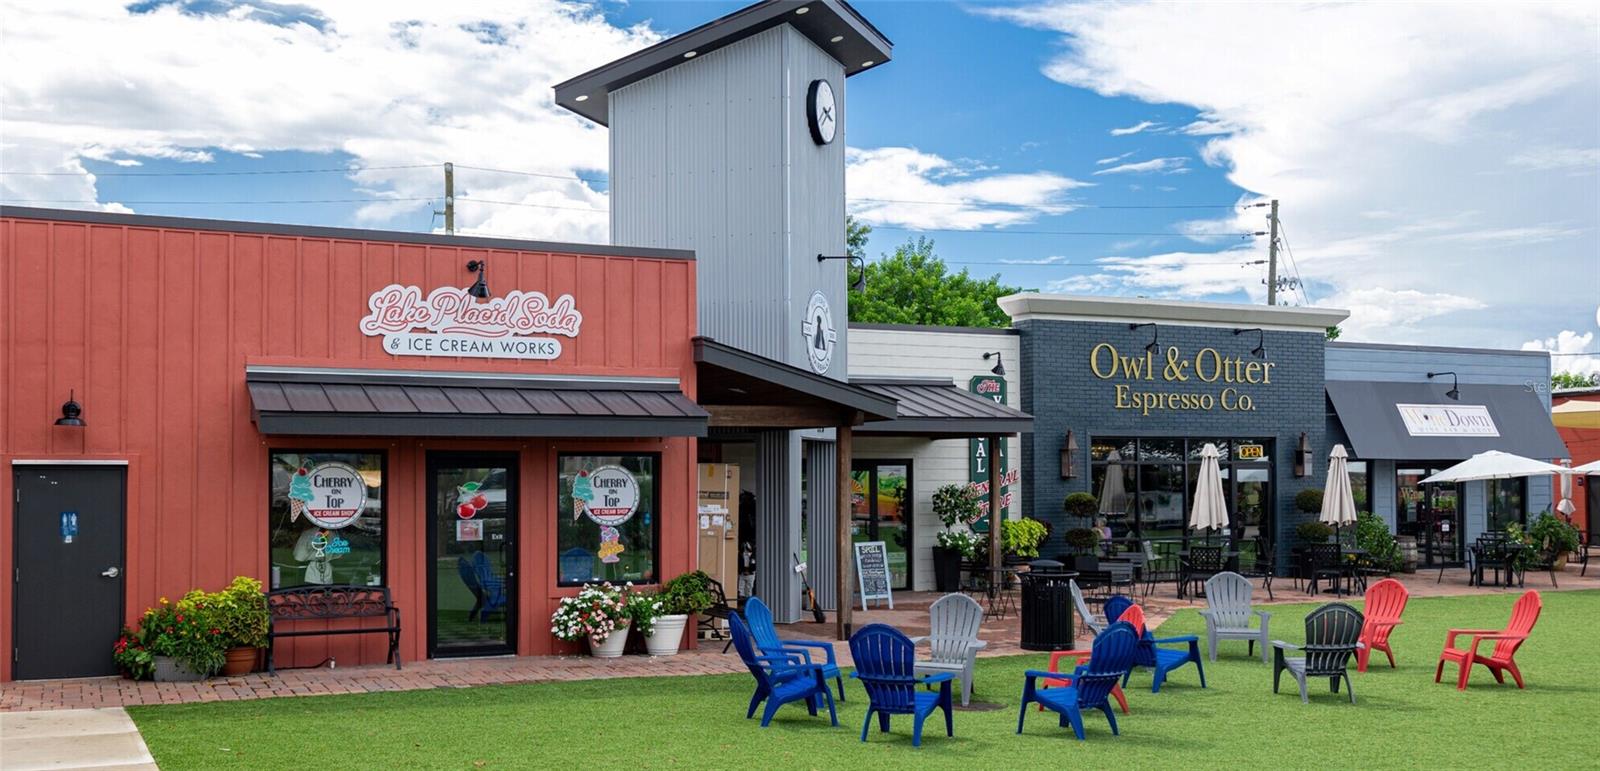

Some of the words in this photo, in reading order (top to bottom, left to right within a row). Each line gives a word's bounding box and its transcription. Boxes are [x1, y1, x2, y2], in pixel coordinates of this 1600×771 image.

[366, 289, 430, 332] Lake
[431, 291, 515, 328] Placid
[516, 297, 576, 332] Soda
[390, 337, 400, 350] &
[408, 338, 432, 351] ICE
[439, 339, 493, 353] CREAM
[500, 341, 555, 355] WORKS
[1090, 343, 1154, 380] Owl
[1163, 346, 1189, 381] &
[1195, 348, 1275, 384] Otter
[1115, 384, 1214, 416] Espresso
[1220, 388, 1256, 411] Co.
[1241, 446, 1263, 457] OPEN
